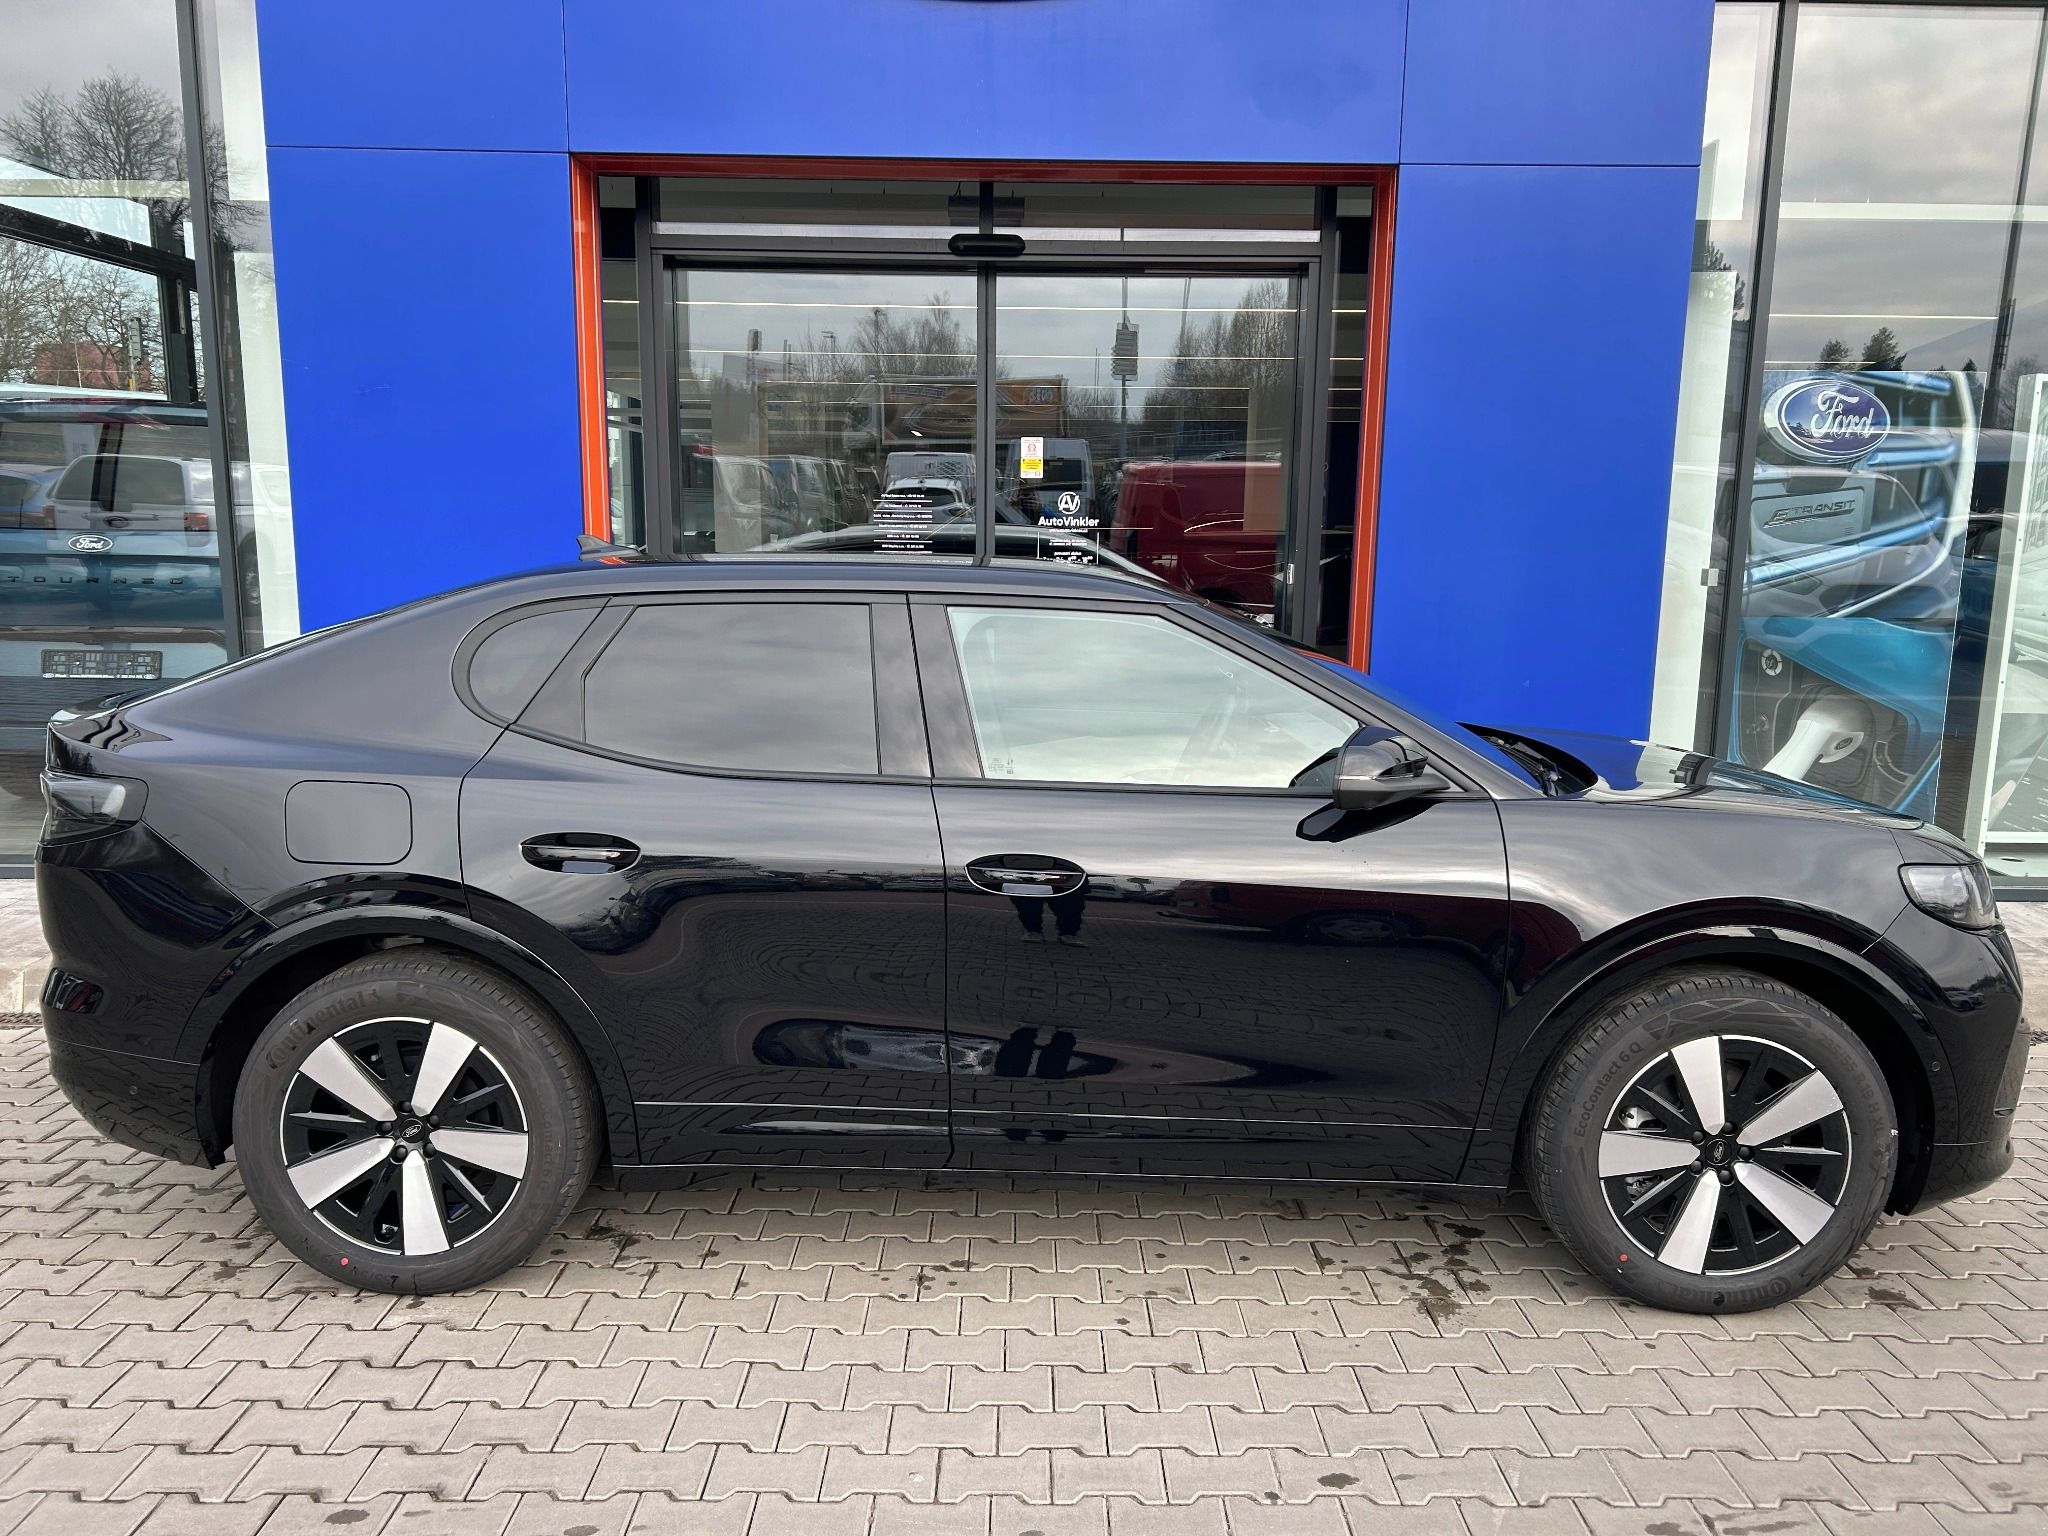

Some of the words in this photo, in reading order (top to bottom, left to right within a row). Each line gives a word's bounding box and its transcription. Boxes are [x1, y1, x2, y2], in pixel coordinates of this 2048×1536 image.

[1811, 391, 1875, 438] Ford
[1037, 516, 1100, 527] AutoVinkler
[74, 537, 106, 550] Ford
[7, 575, 185, 585] TOURNEO
[266, 991, 368, 1069] Continental
[1573, 1059, 1622, 1137] EcoContact
[1619, 1049, 1631, 1063] 6
[1629, 1041, 1645, 1054] Q
